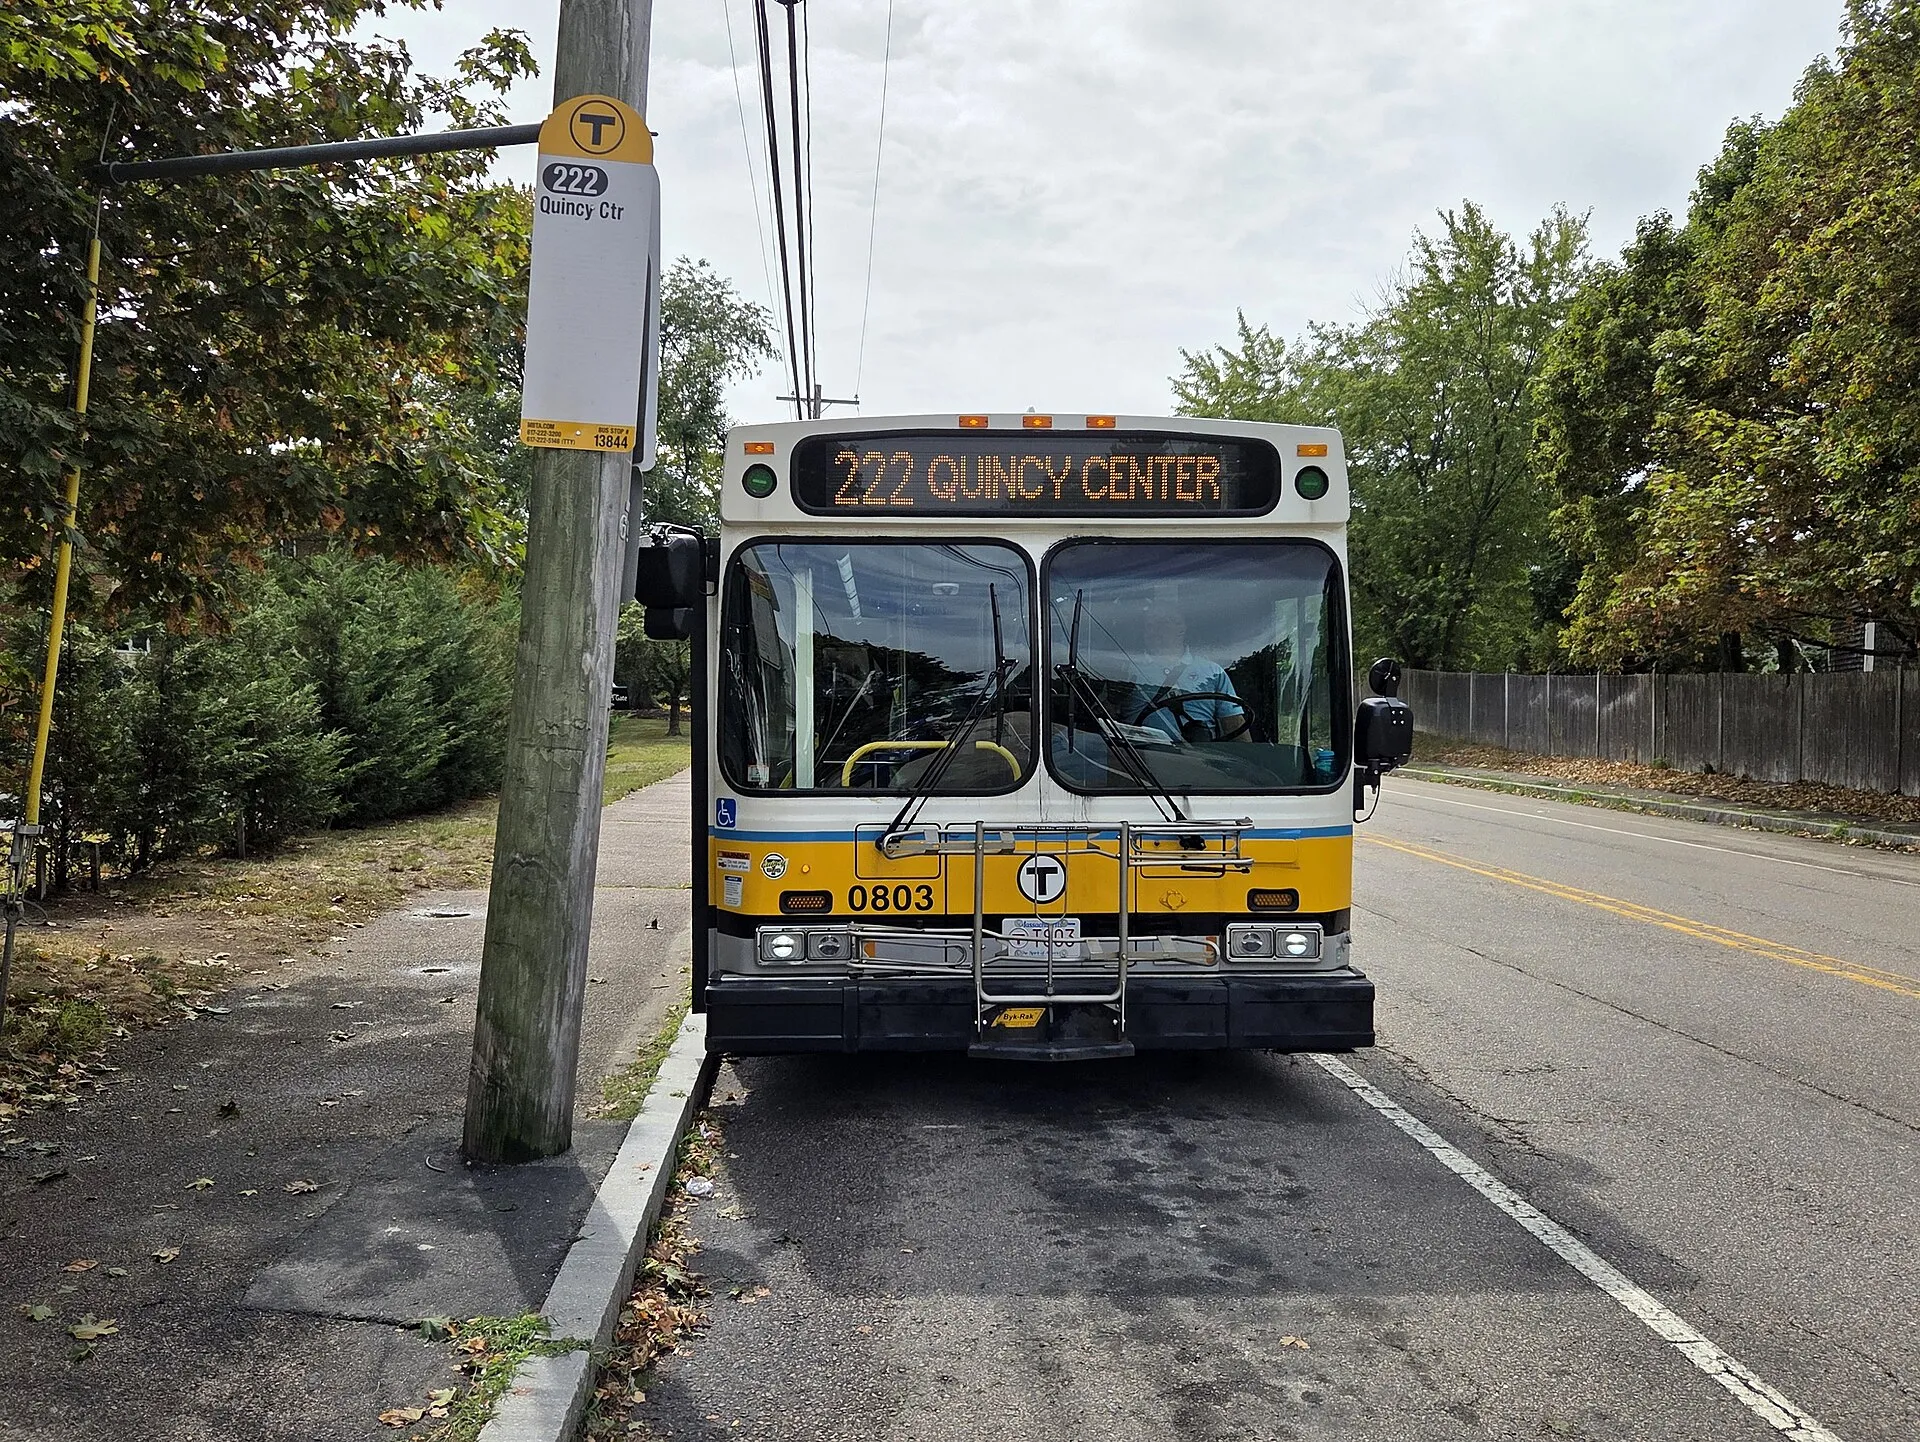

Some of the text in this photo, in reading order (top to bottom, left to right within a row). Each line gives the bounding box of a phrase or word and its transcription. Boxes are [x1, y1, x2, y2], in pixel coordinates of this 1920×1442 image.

[580, 113, 616, 146] T
[552, 165, 598, 194] 222
[540, 195, 625, 221] Quincy Ctr
[561, 438, 576, 446] (TTY)
[594, 434, 628, 449] 13844
[610, 427, 624, 435] STOP
[834, 451, 1221, 505] 222 QUINCY CENTER
[1026, 866, 1058, 895] T
[848, 884, 934, 911] 0803
[1003, 1013, 1034, 1021] Byk-Rak
